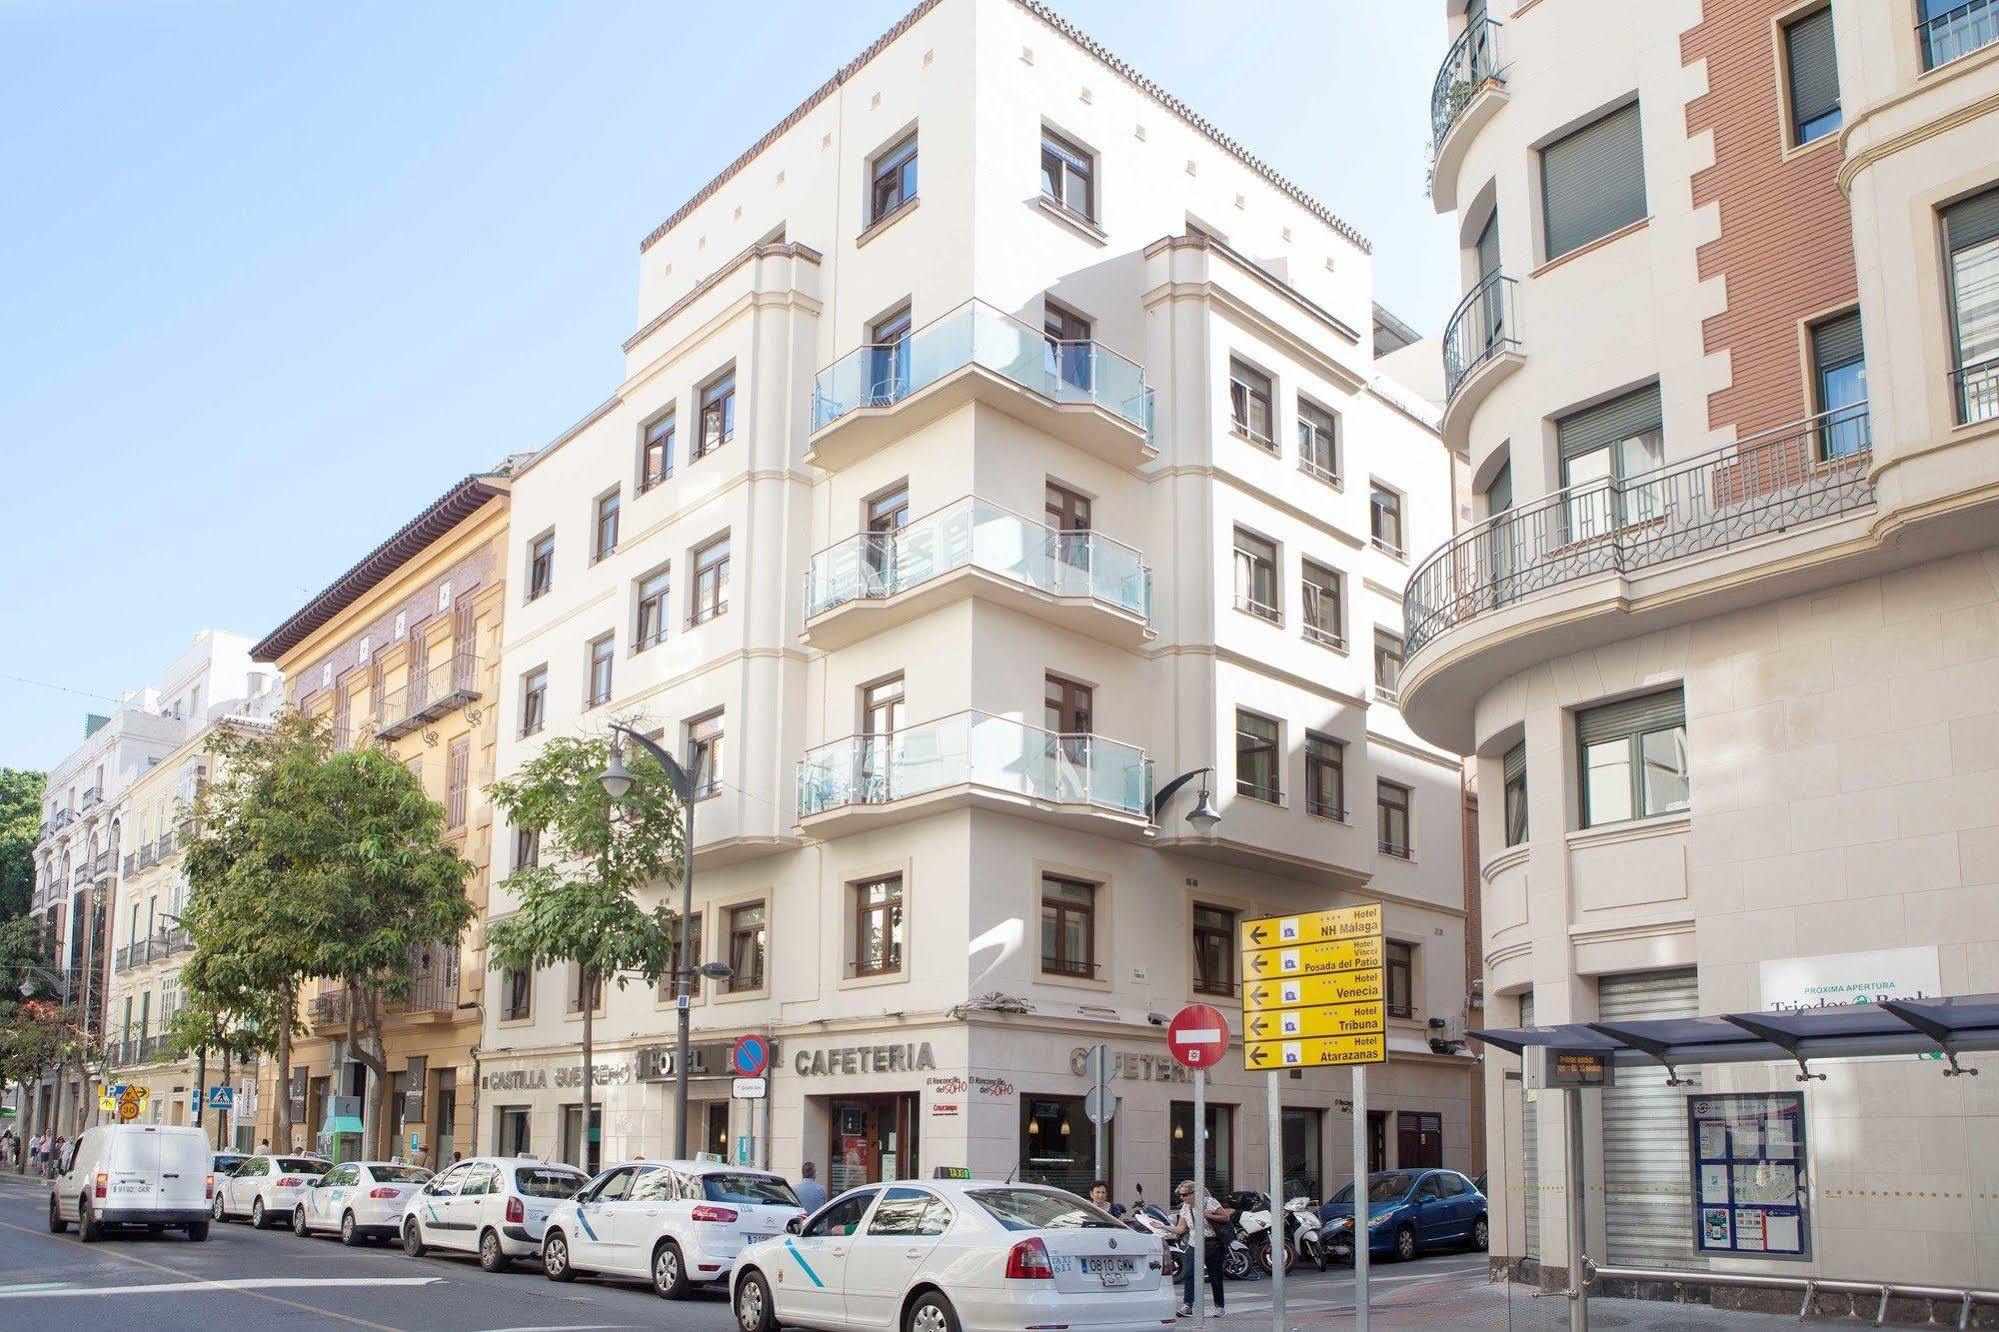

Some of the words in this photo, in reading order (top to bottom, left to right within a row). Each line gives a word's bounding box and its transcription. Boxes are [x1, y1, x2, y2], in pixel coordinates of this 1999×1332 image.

[1354, 908, 1377, 919] Hotel
[1321, 925, 1336, 937] NH
[1340, 921, 1378, 934] Málaga
[1353, 940, 1373, 948] Hotel
[1354, 948, 1377, 957] Vincci
[1305, 962, 1336, 972] Posada
[1338, 960, 1352, 969] del
[1355, 958, 1378, 967] Patio
[1354, 973, 1377, 983] Hotel
[1336, 985, 1378, 998] Venecia
[1846, 981, 1896, 992] APERTURA
[1354, 1007, 1377, 1016] Hotel
[1339, 1019, 1378, 1031] Tribuna
[1354, 1037, 1377, 1046] Hotel
[795, 1041, 936, 1076] CAFETERIA
[1320, 1050, 1379, 1062] Atarazanas
[489, 1068, 548, 1090] CASTILLA
[554, 1062, 631, 1088] GUERERO
[968, 1076, 975, 1084] El
[936, 1085, 944, 1093] del
[943, 1081, 968, 1094] SOHO
[980, 1085, 988, 1093] del
[988, 1084, 1014, 1096] SOHO
[1089, 1259, 1114, 1272] 0810
